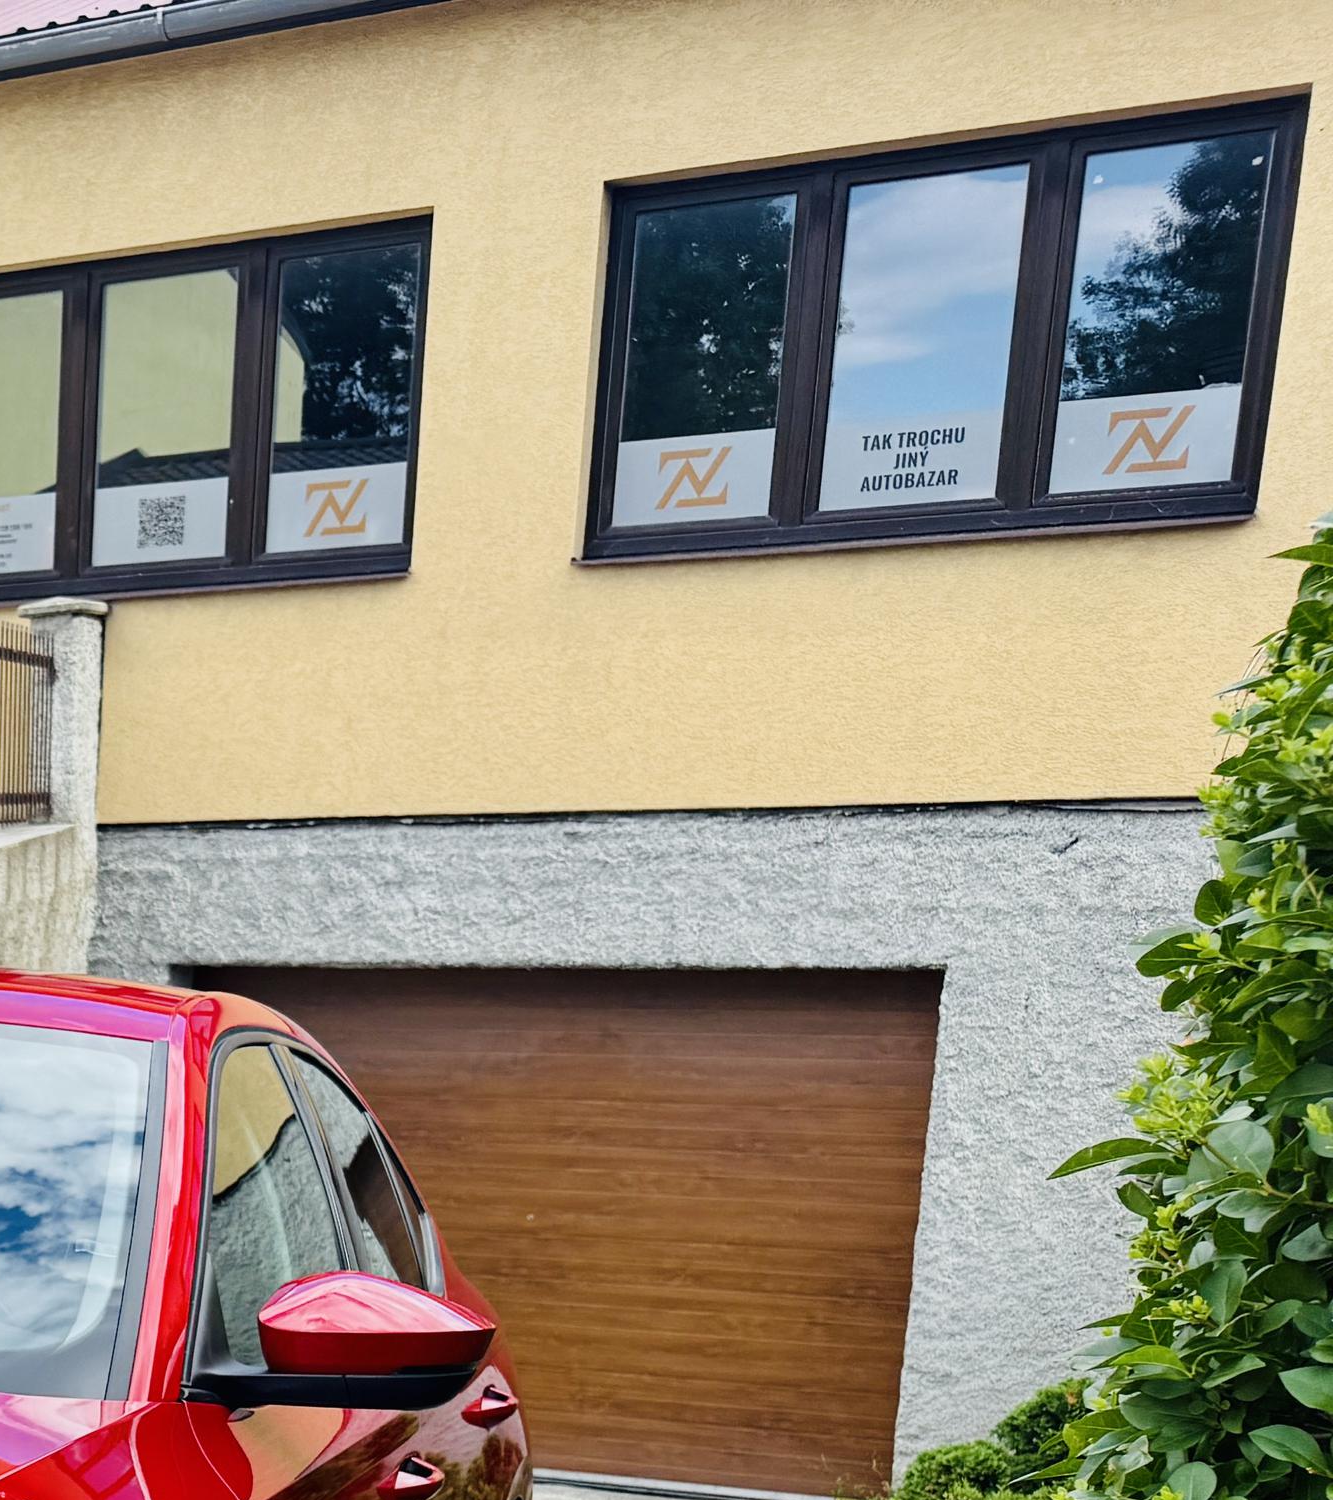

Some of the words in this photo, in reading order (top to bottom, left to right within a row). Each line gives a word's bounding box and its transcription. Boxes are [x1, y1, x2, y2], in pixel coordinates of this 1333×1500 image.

[861, 432, 893, 451] TAK
[897, 426, 966, 450] TROCHU
[893, 446, 929, 470] JINÝ
[860, 469, 959, 492] AUTOBAZAR
